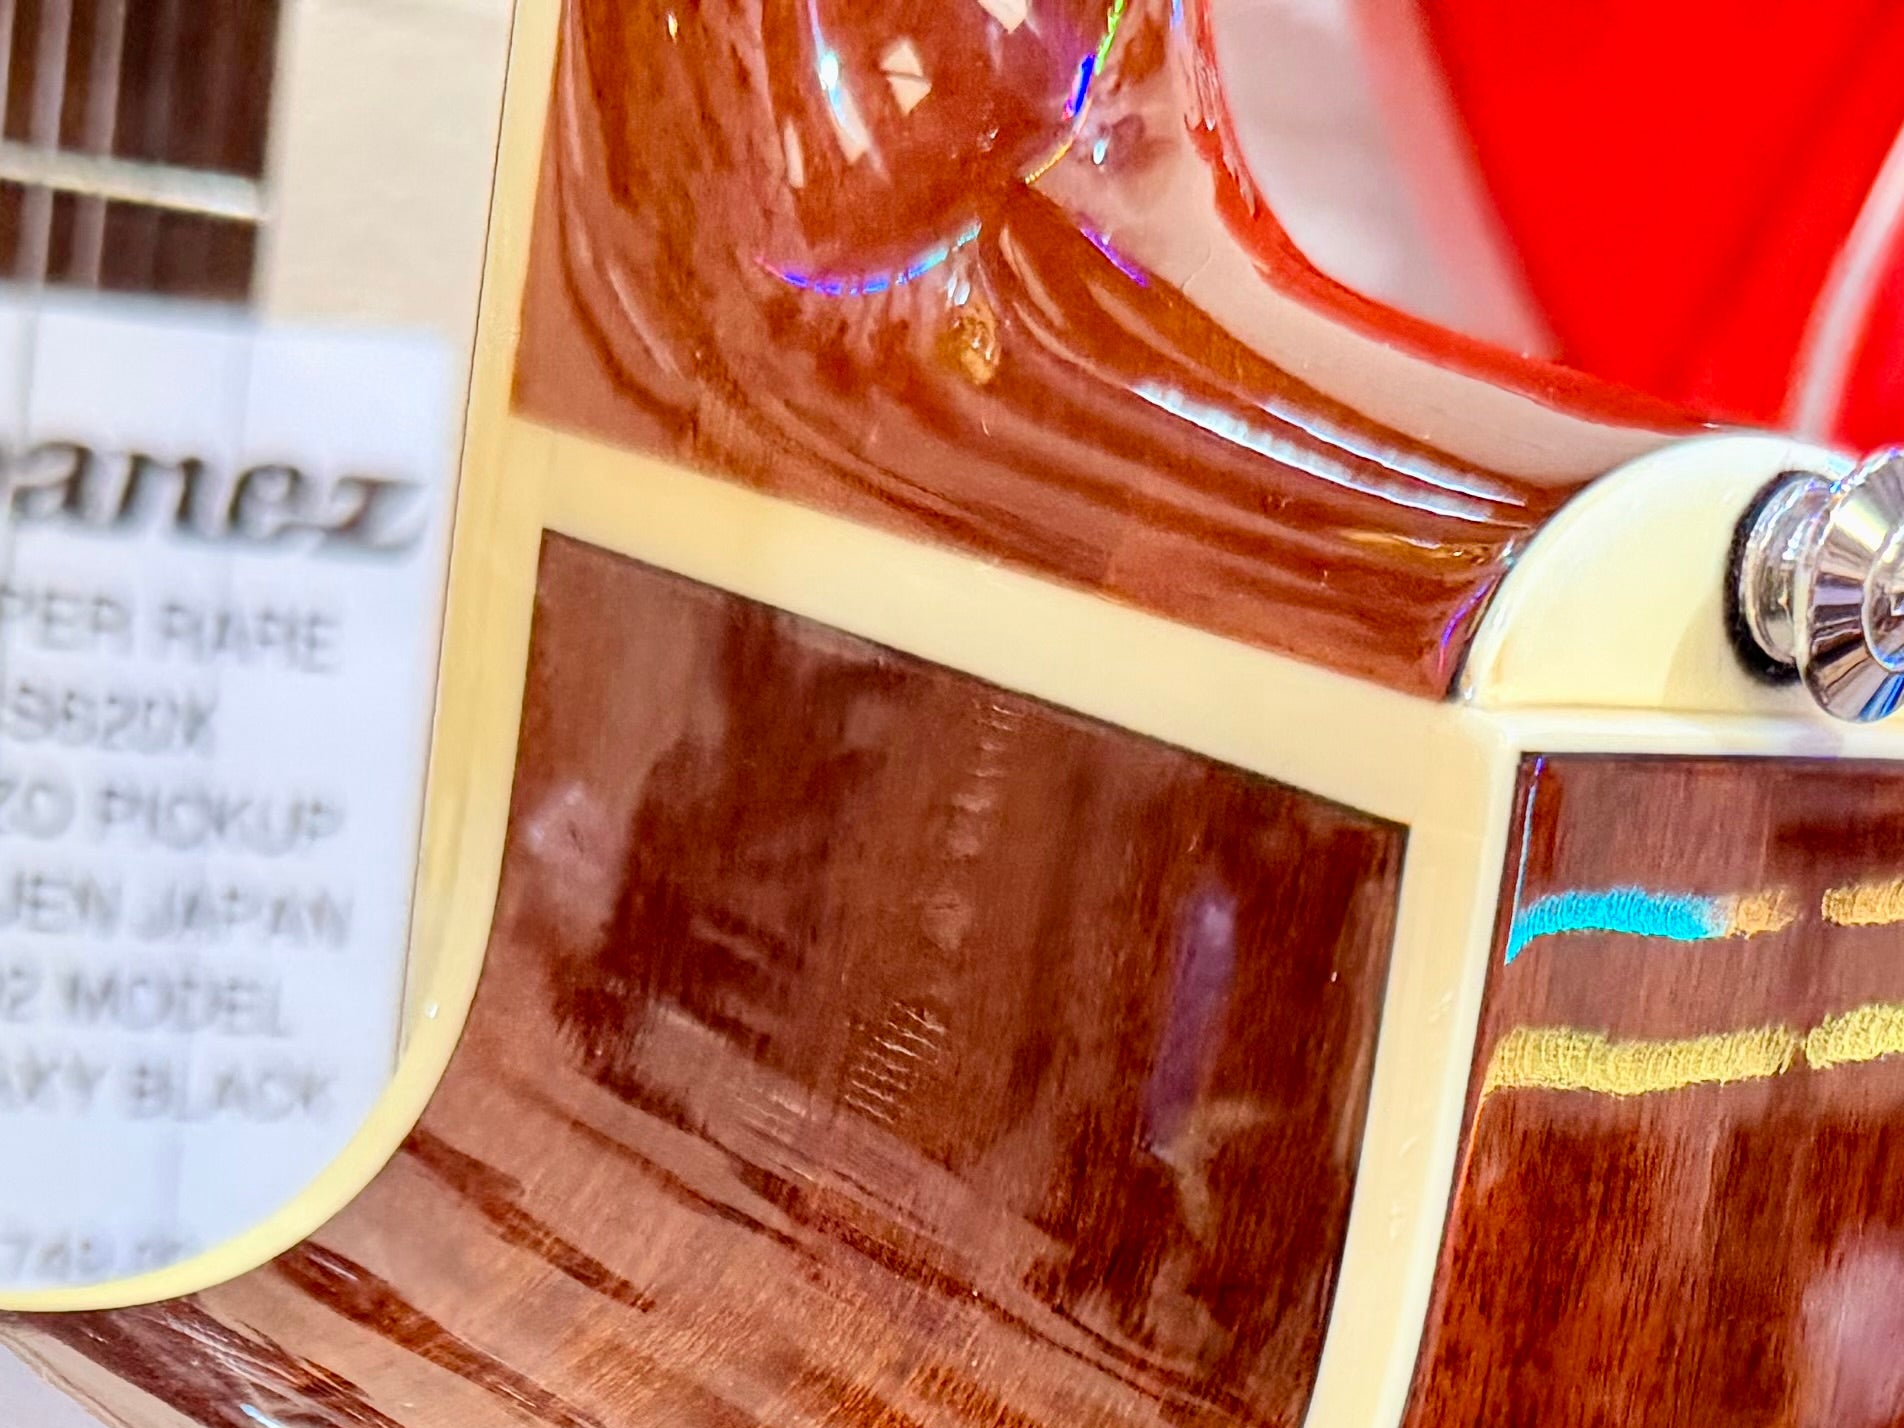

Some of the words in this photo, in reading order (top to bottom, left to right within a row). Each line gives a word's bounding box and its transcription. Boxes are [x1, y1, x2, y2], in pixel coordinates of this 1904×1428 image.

[159, 598, 344, 674] RARE
[96, 780, 346, 857] PICKUP
[135, 882, 355, 950] JAPAN
[60, 968, 292, 1040] MODEL
[123, 1060, 340, 1126] BLACK
